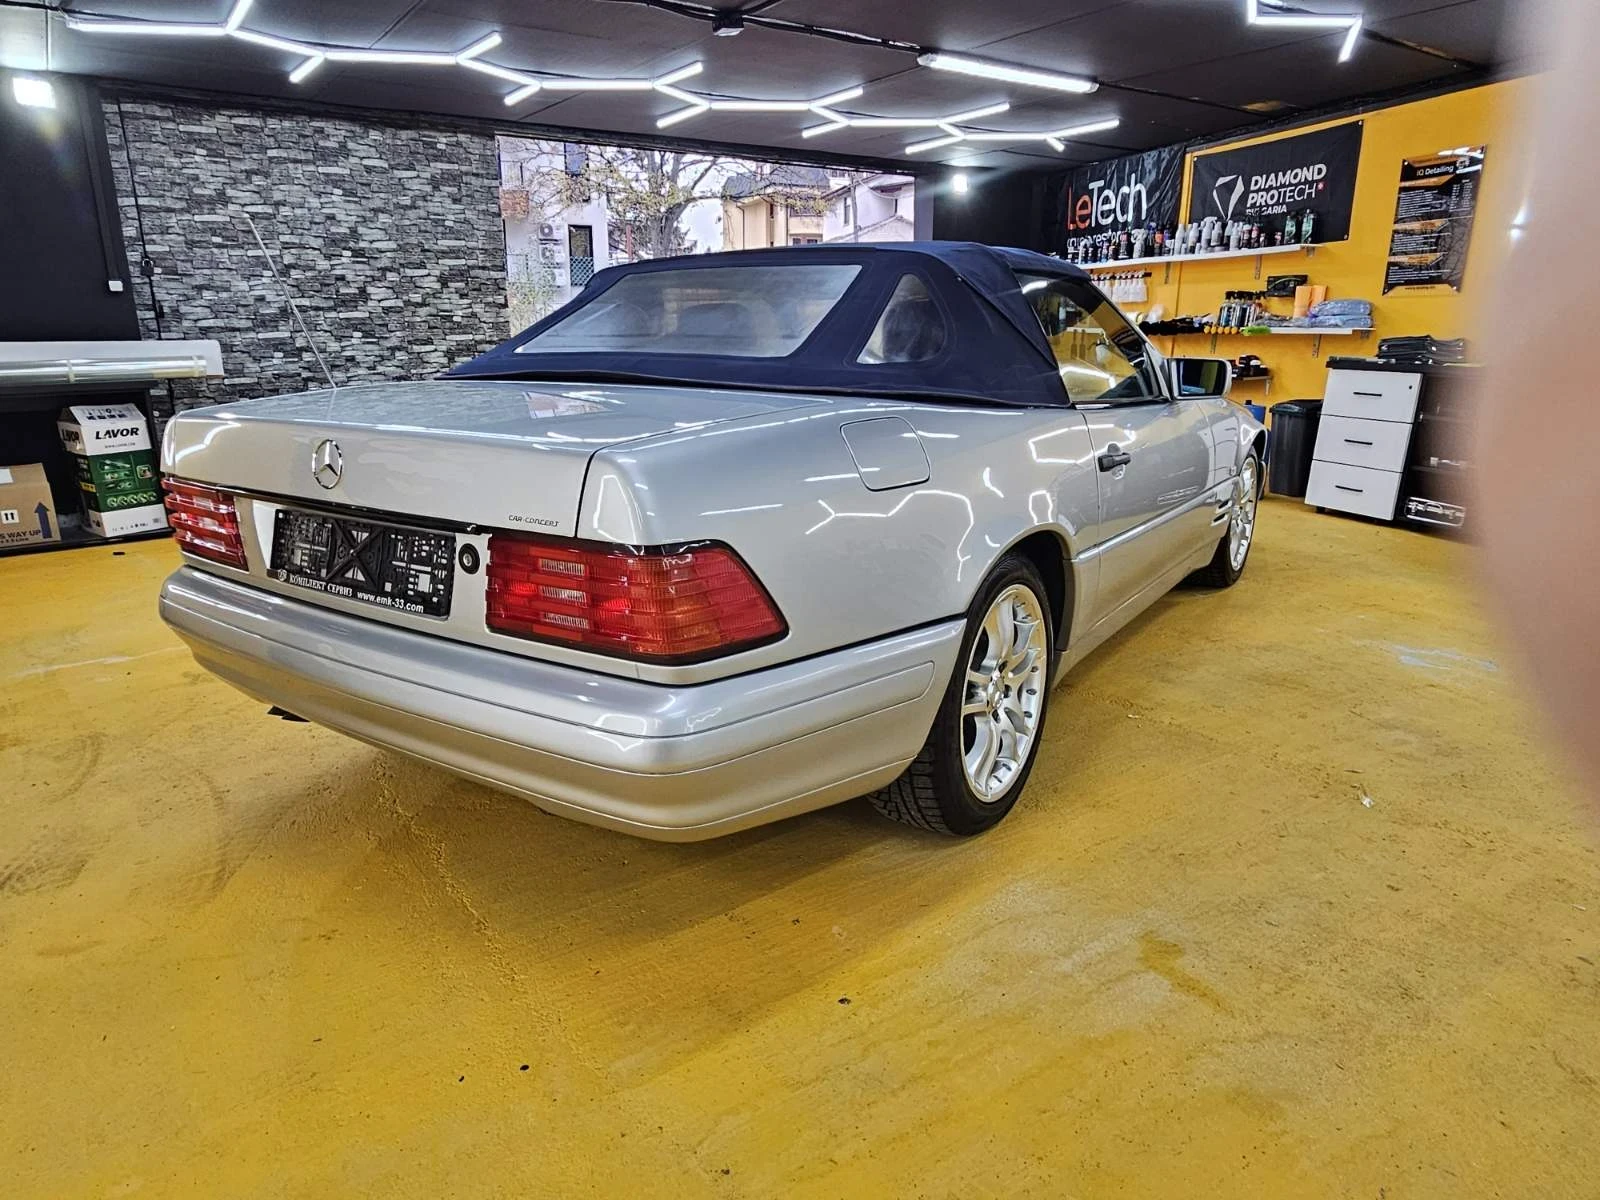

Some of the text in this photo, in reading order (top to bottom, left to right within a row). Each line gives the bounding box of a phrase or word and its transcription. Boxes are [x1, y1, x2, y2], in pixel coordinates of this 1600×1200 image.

[1250, 163, 1327, 191] DIAMOND
[1425, 165, 1454, 176] Detailing
[1067, 172, 1148, 230] LeTech
[1246, 182, 1317, 208] PROTECH
[95, 427, 140, 440] LAVOR
[7, 531, 28, 539] WAY
[29, 529, 41, 537] UP
[357, 590, 424, 613] www.emk-33.com
